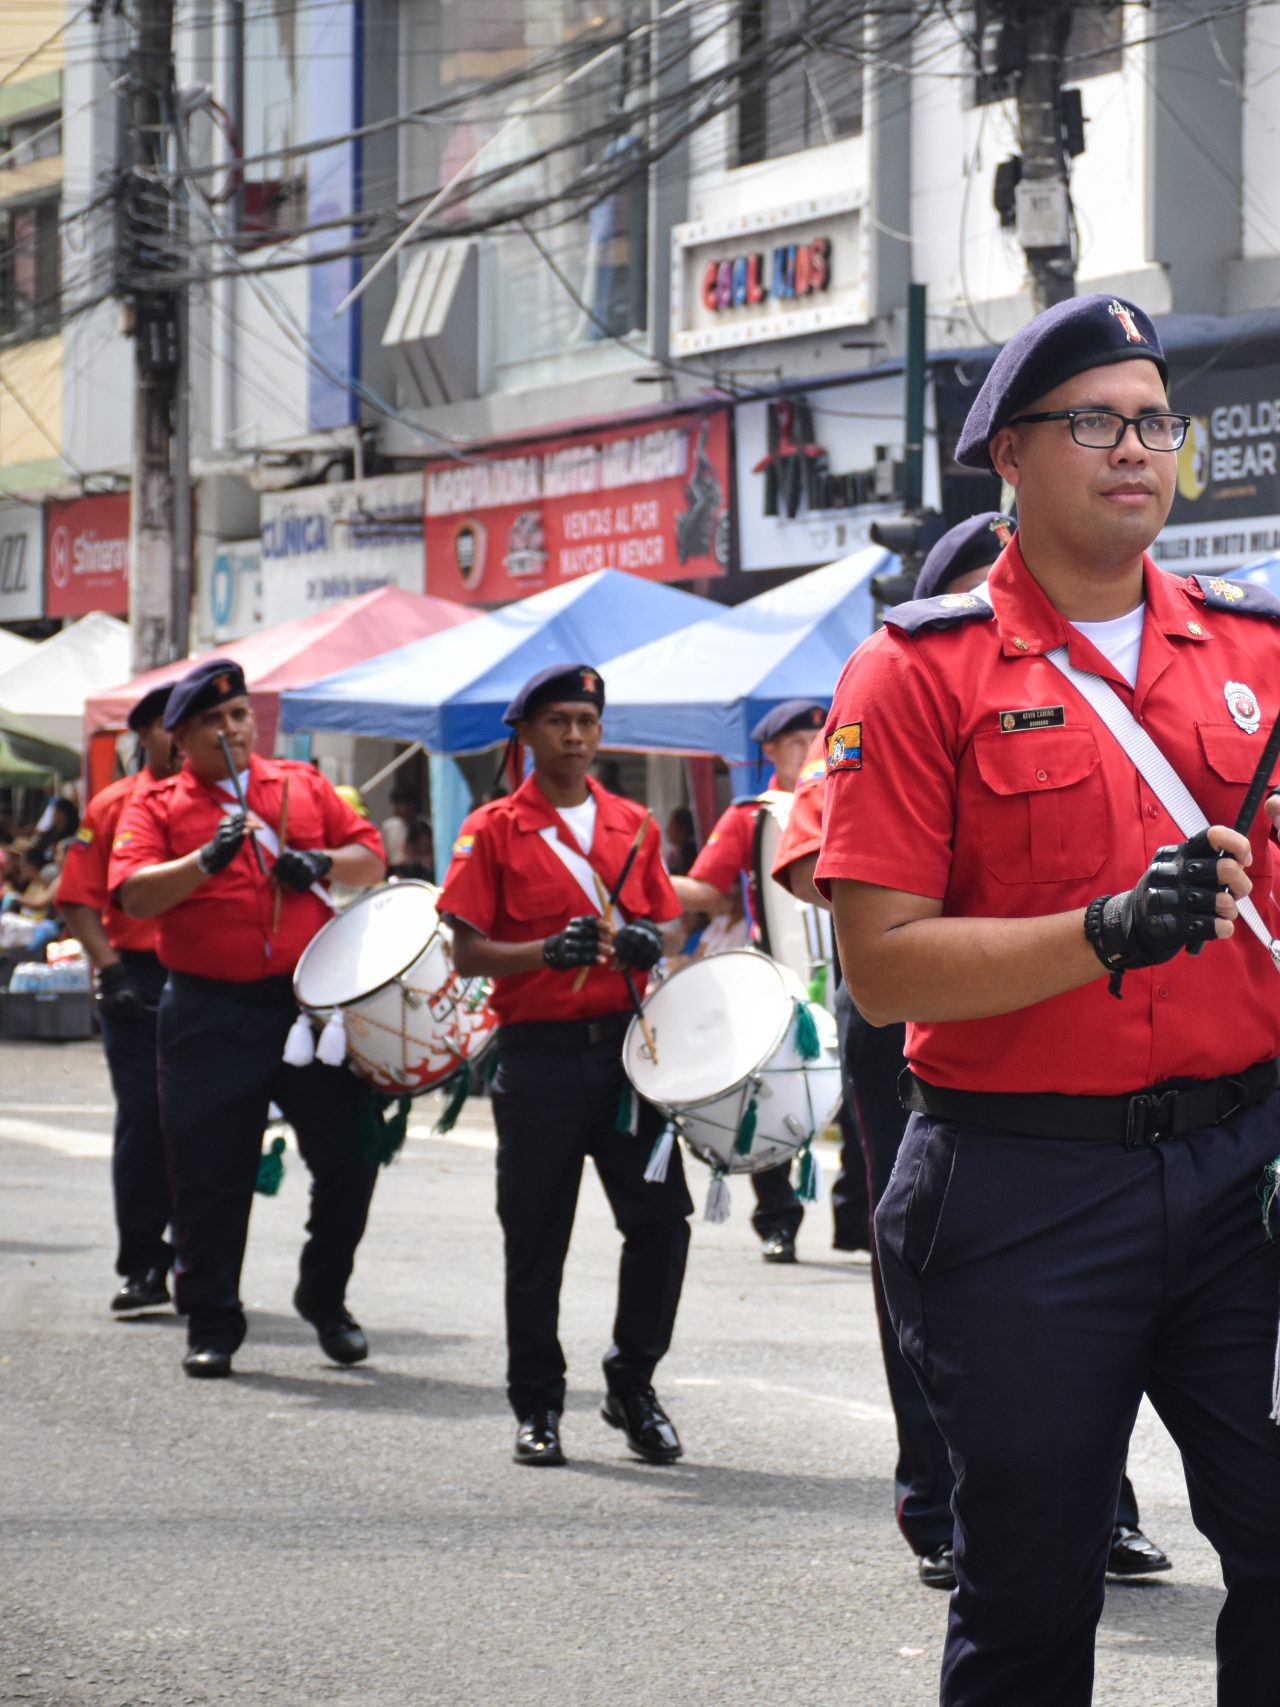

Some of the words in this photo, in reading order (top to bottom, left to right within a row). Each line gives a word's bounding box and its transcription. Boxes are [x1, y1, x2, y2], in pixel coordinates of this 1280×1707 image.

[1211, 442, 1277, 482] BEAR
[562, 507, 613, 541] VENTAS
[615, 504, 632, 534] AL
[632, 501, 661, 531] POR
[560, 543, 606, 577] MAYOR
[607, 542, 617, 569] Y
[619, 535, 665, 568] MENOR
[1153, 538, 1190, 561] TALLER
[1194, 536, 1208, 558] DE
[1213, 533, 1245, 556] MOTO
